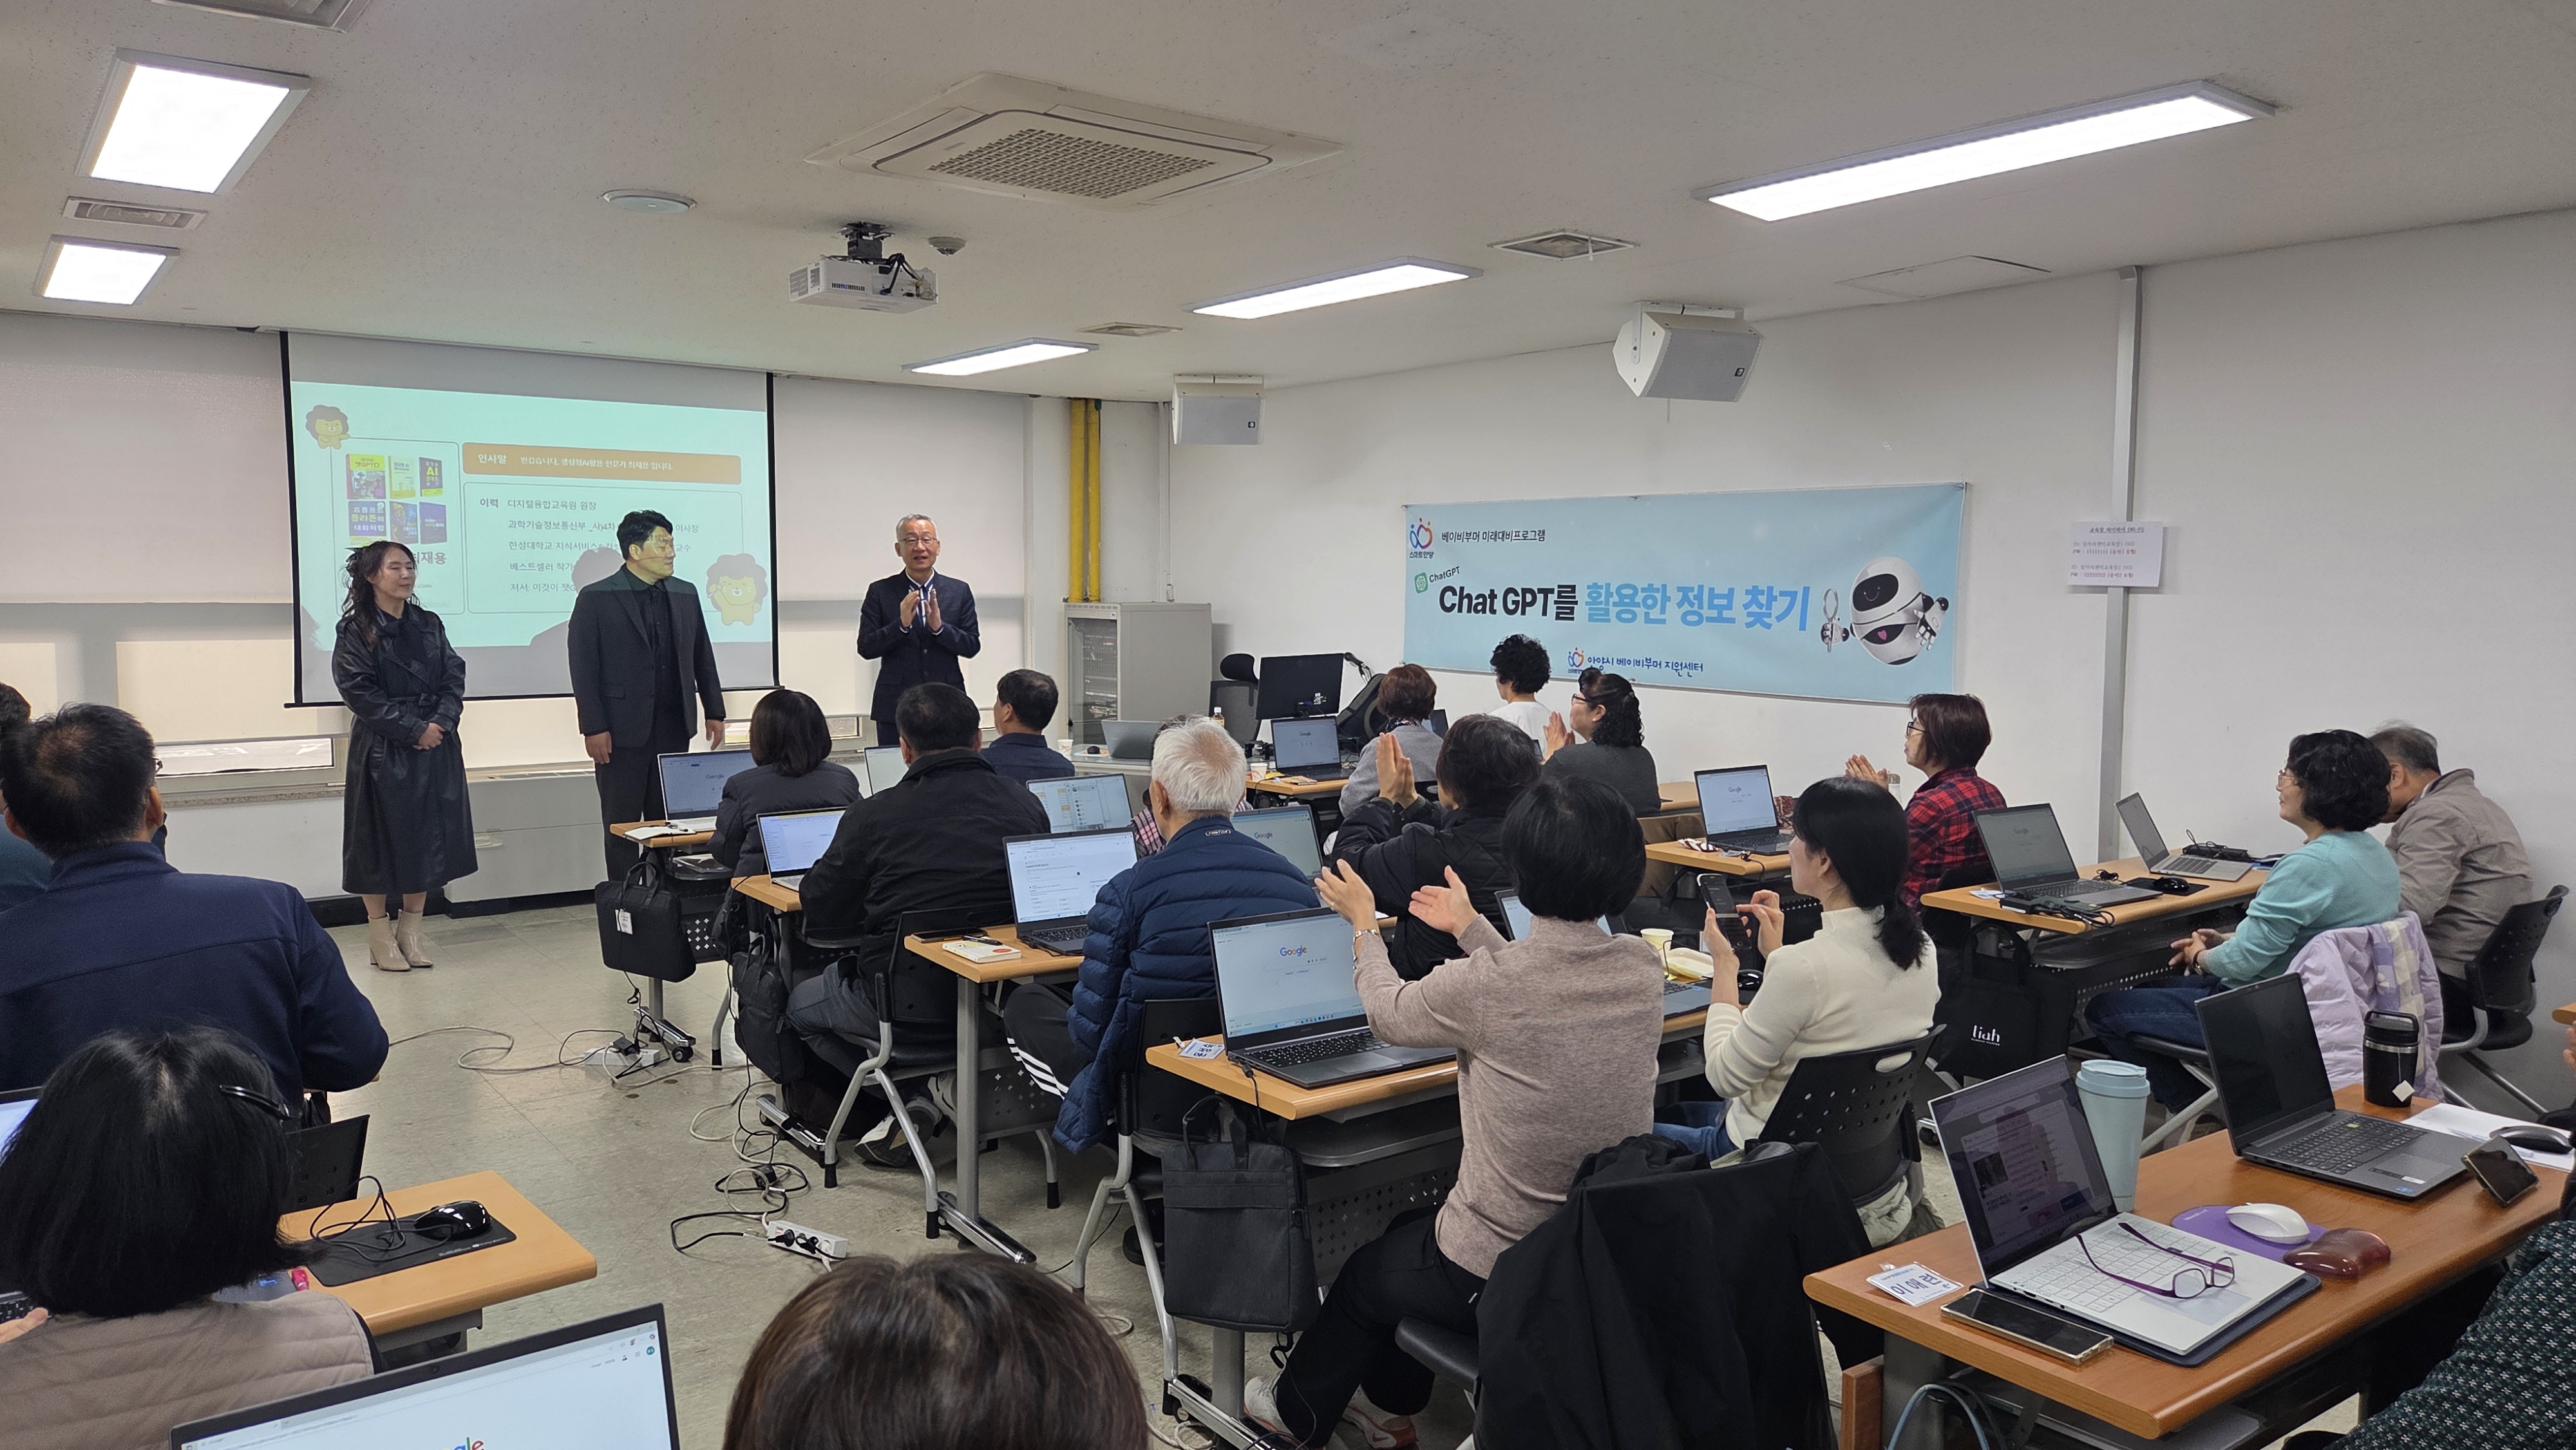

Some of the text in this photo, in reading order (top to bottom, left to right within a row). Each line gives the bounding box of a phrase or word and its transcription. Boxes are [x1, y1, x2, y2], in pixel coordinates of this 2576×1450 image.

[478, 453, 507, 464] 인사말
[426, 466, 439, 476] AI
[480, 498, 596, 511] 이력 디지털융합교육원 원장
[507, 520, 586, 531] 과학기술정보통신부
[676, 524, 699, 533] 이사장
[1441, 529, 1546, 543] 베이비부머 미래대비프로그램
[509, 541, 552, 551] 한성대학교
[509, 562, 553, 572] 베스트셀러
[1429, 566, 1461, 583] ChatGPT
[533, 583, 558, 592] 이것이
[1439, 582, 1811, 632] Chat GPT를 활용한 정보 찾기
[1616, 657, 1662, 670] 베이비부머
[1665, 661, 1703, 677] 지원센터
[1280, 945, 1307, 957] Google
[1973, 1024, 2000, 1042] liah
